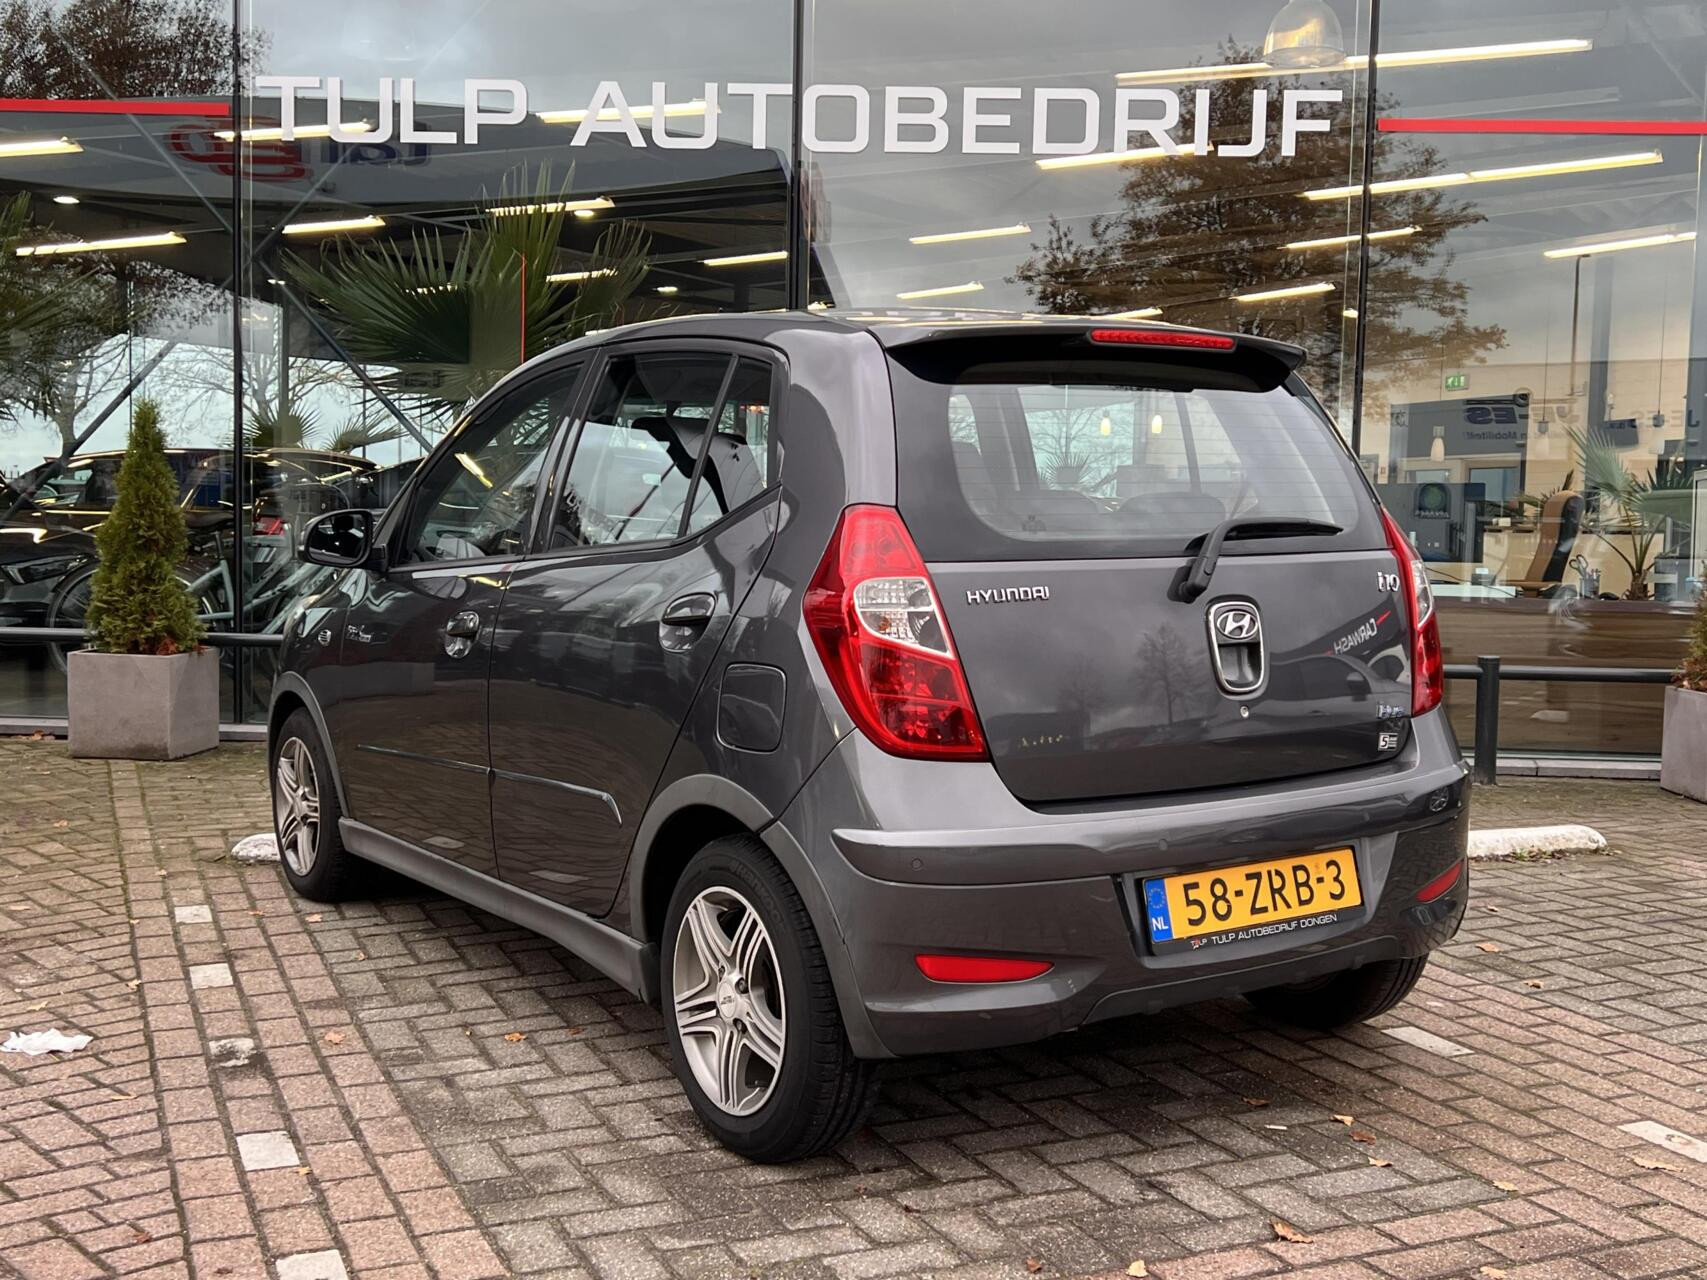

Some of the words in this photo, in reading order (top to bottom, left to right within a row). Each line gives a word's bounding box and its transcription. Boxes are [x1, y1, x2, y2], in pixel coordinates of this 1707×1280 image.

[255, 76, 528, 145] TULP
[570, 80, 1343, 158] AUTOBEDRIJF
[966, 585, 1050, 605] HYUNDAI
[1377, 570, 1400, 593] i10
[1182, 860, 1345, 927] 58-ZRB-3
[1151, 916, 1169, 931] NL
[1211, 932, 1236, 945] TULP
[1238, 920, 1299, 938] AUTOBEDRIJF
[1300, 913, 1338, 930] DONGEN
